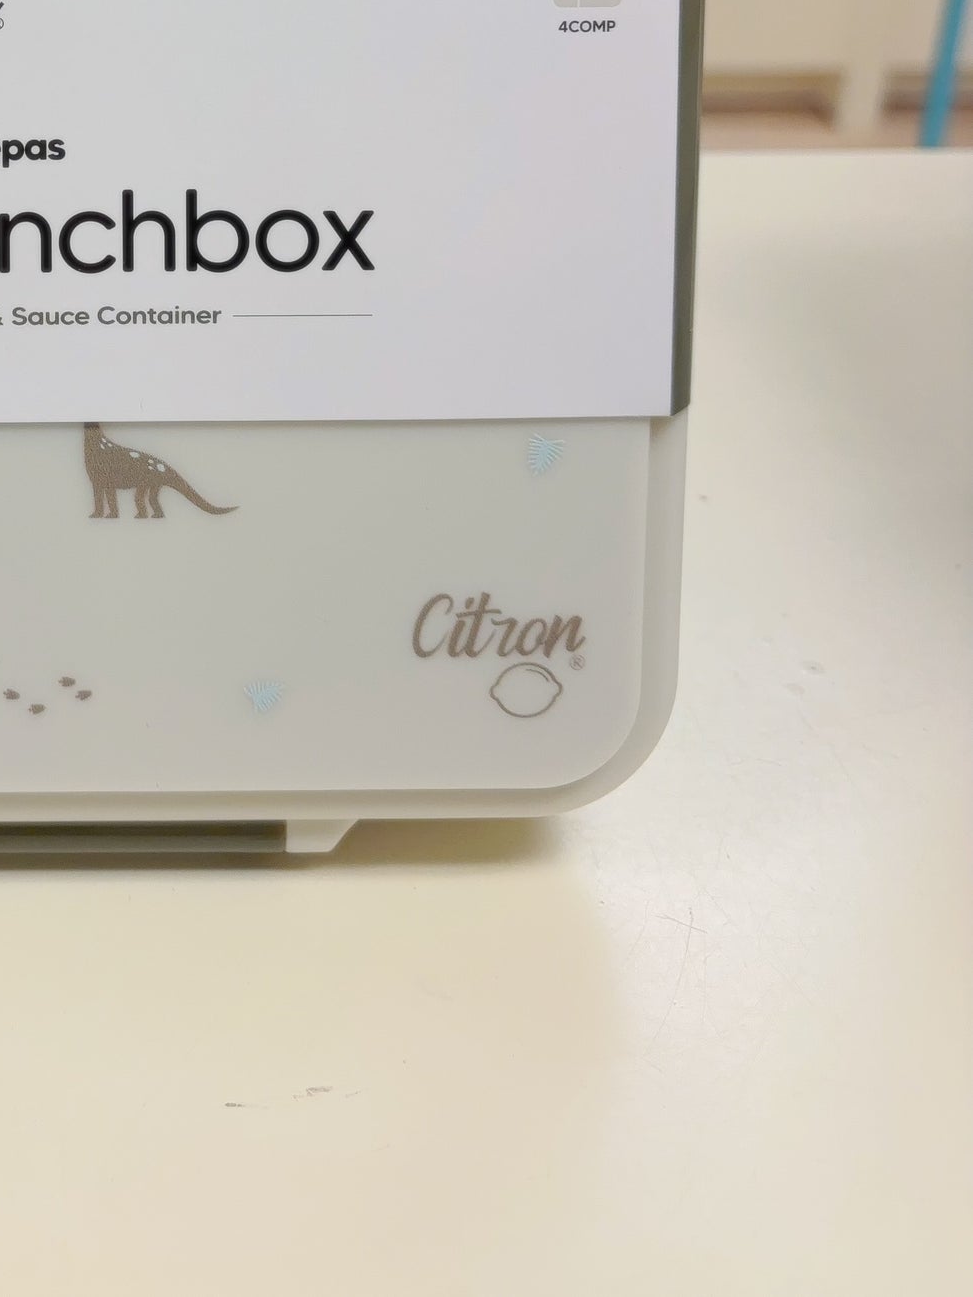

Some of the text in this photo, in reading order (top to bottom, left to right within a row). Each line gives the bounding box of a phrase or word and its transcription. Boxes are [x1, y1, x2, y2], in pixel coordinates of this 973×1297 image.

[558, 19, 617, 33] 4COMP
[11, 306, 90, 326] Sauce
[97, 305, 222, 325] Container
[411, 591, 587, 659] Citron
